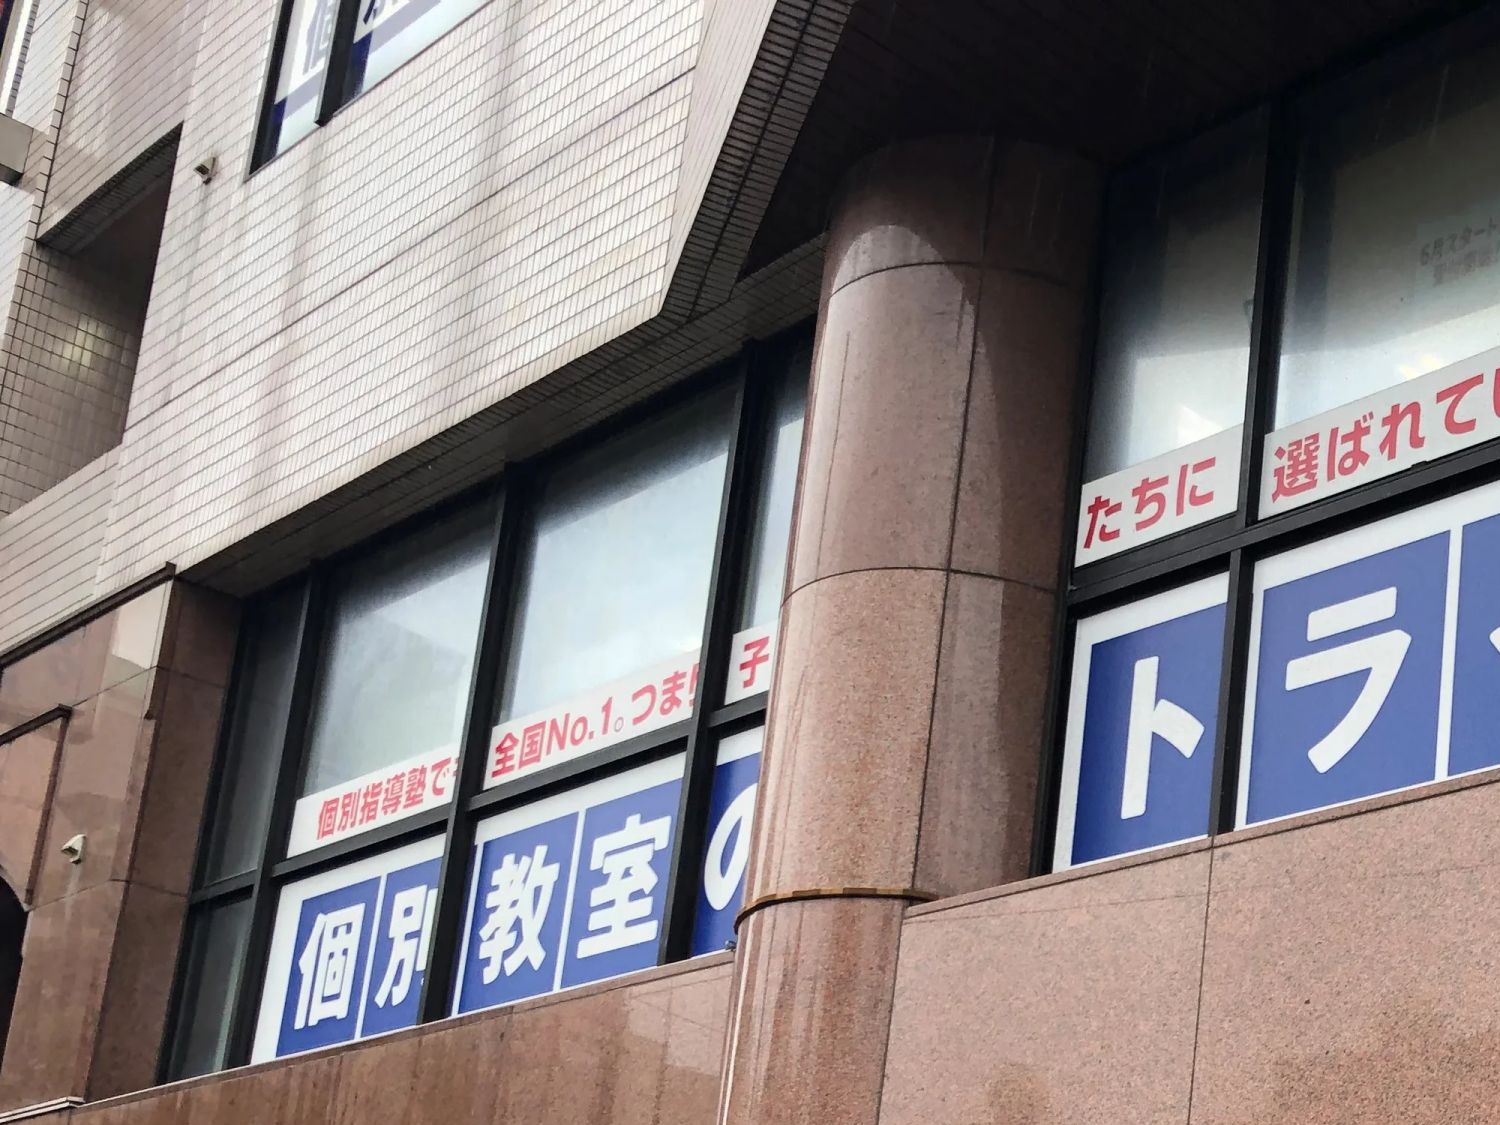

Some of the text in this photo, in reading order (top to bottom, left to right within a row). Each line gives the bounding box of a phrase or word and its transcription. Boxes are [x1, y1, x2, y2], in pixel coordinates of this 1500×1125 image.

[316, 757, 459, 840] 個別指導塾で
[739, 636, 770, 688] 子
[1083, 456, 1216, 549] たちに
